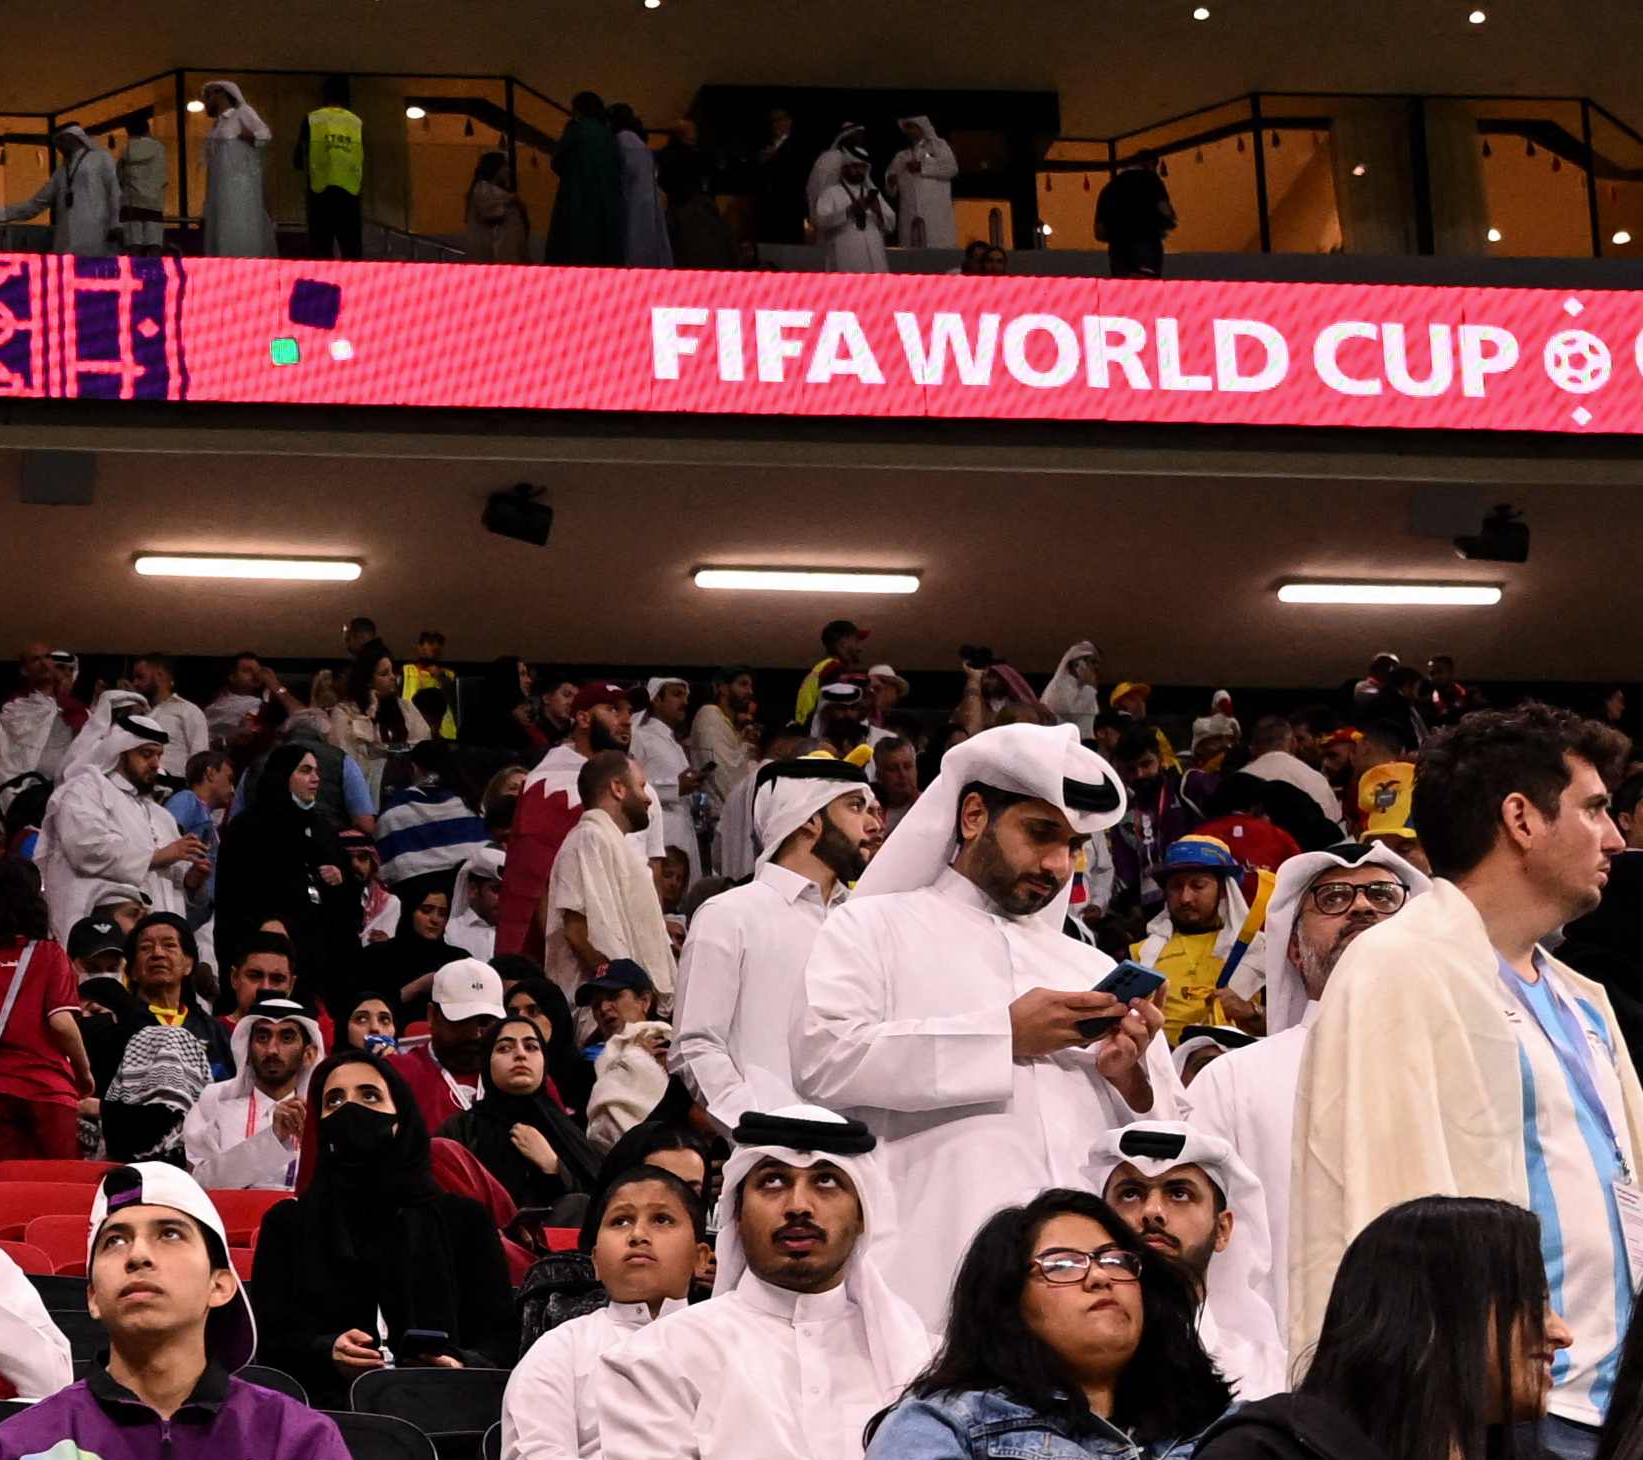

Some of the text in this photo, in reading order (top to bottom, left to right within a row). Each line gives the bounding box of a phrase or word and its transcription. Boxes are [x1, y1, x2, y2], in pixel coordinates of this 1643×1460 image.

[650, 306, 886, 384] FIFA
[893, 311, 1290, 393] WORLD
[1313, 320, 1520, 398] CUP
